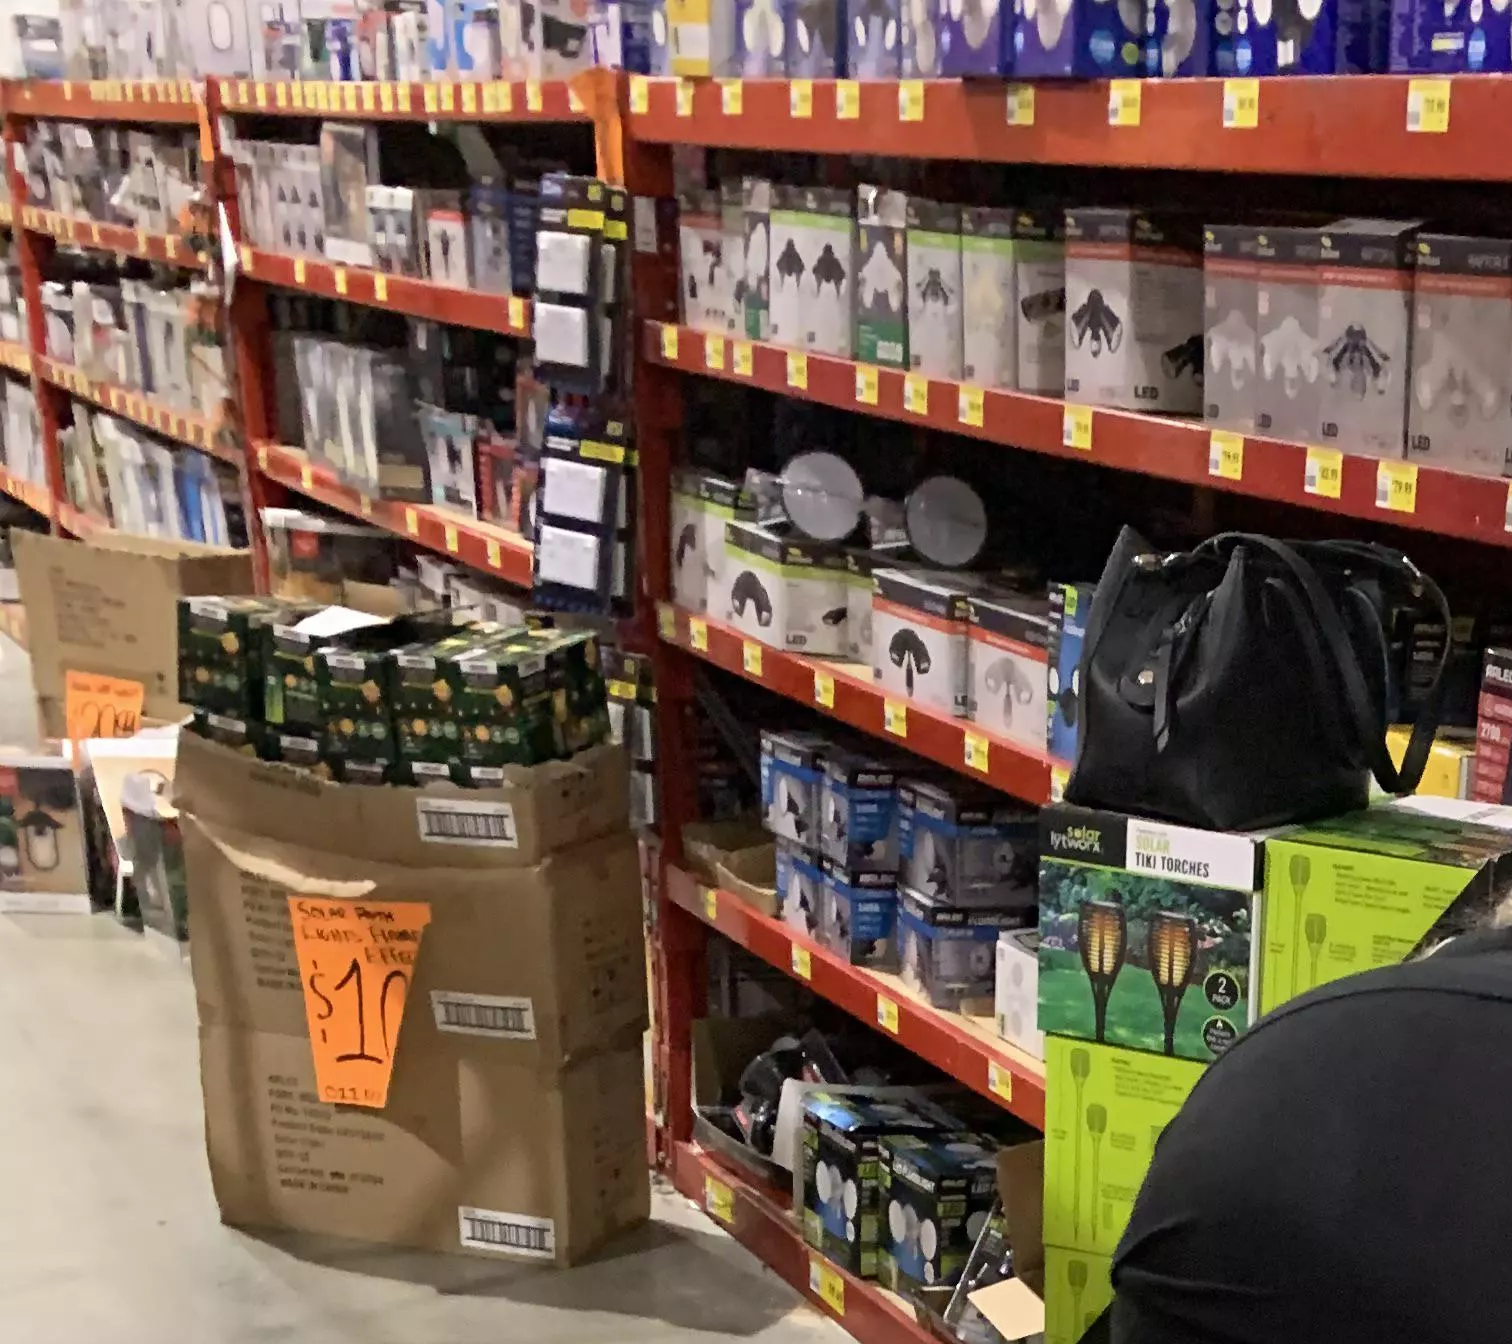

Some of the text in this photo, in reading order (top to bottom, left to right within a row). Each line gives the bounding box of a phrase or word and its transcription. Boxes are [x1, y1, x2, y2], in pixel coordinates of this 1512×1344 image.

[1067, 826, 1102, 843] solar
[1136, 852, 1210, 879] TIKI TORCHES
[1218, 976, 1228, 994] 2
